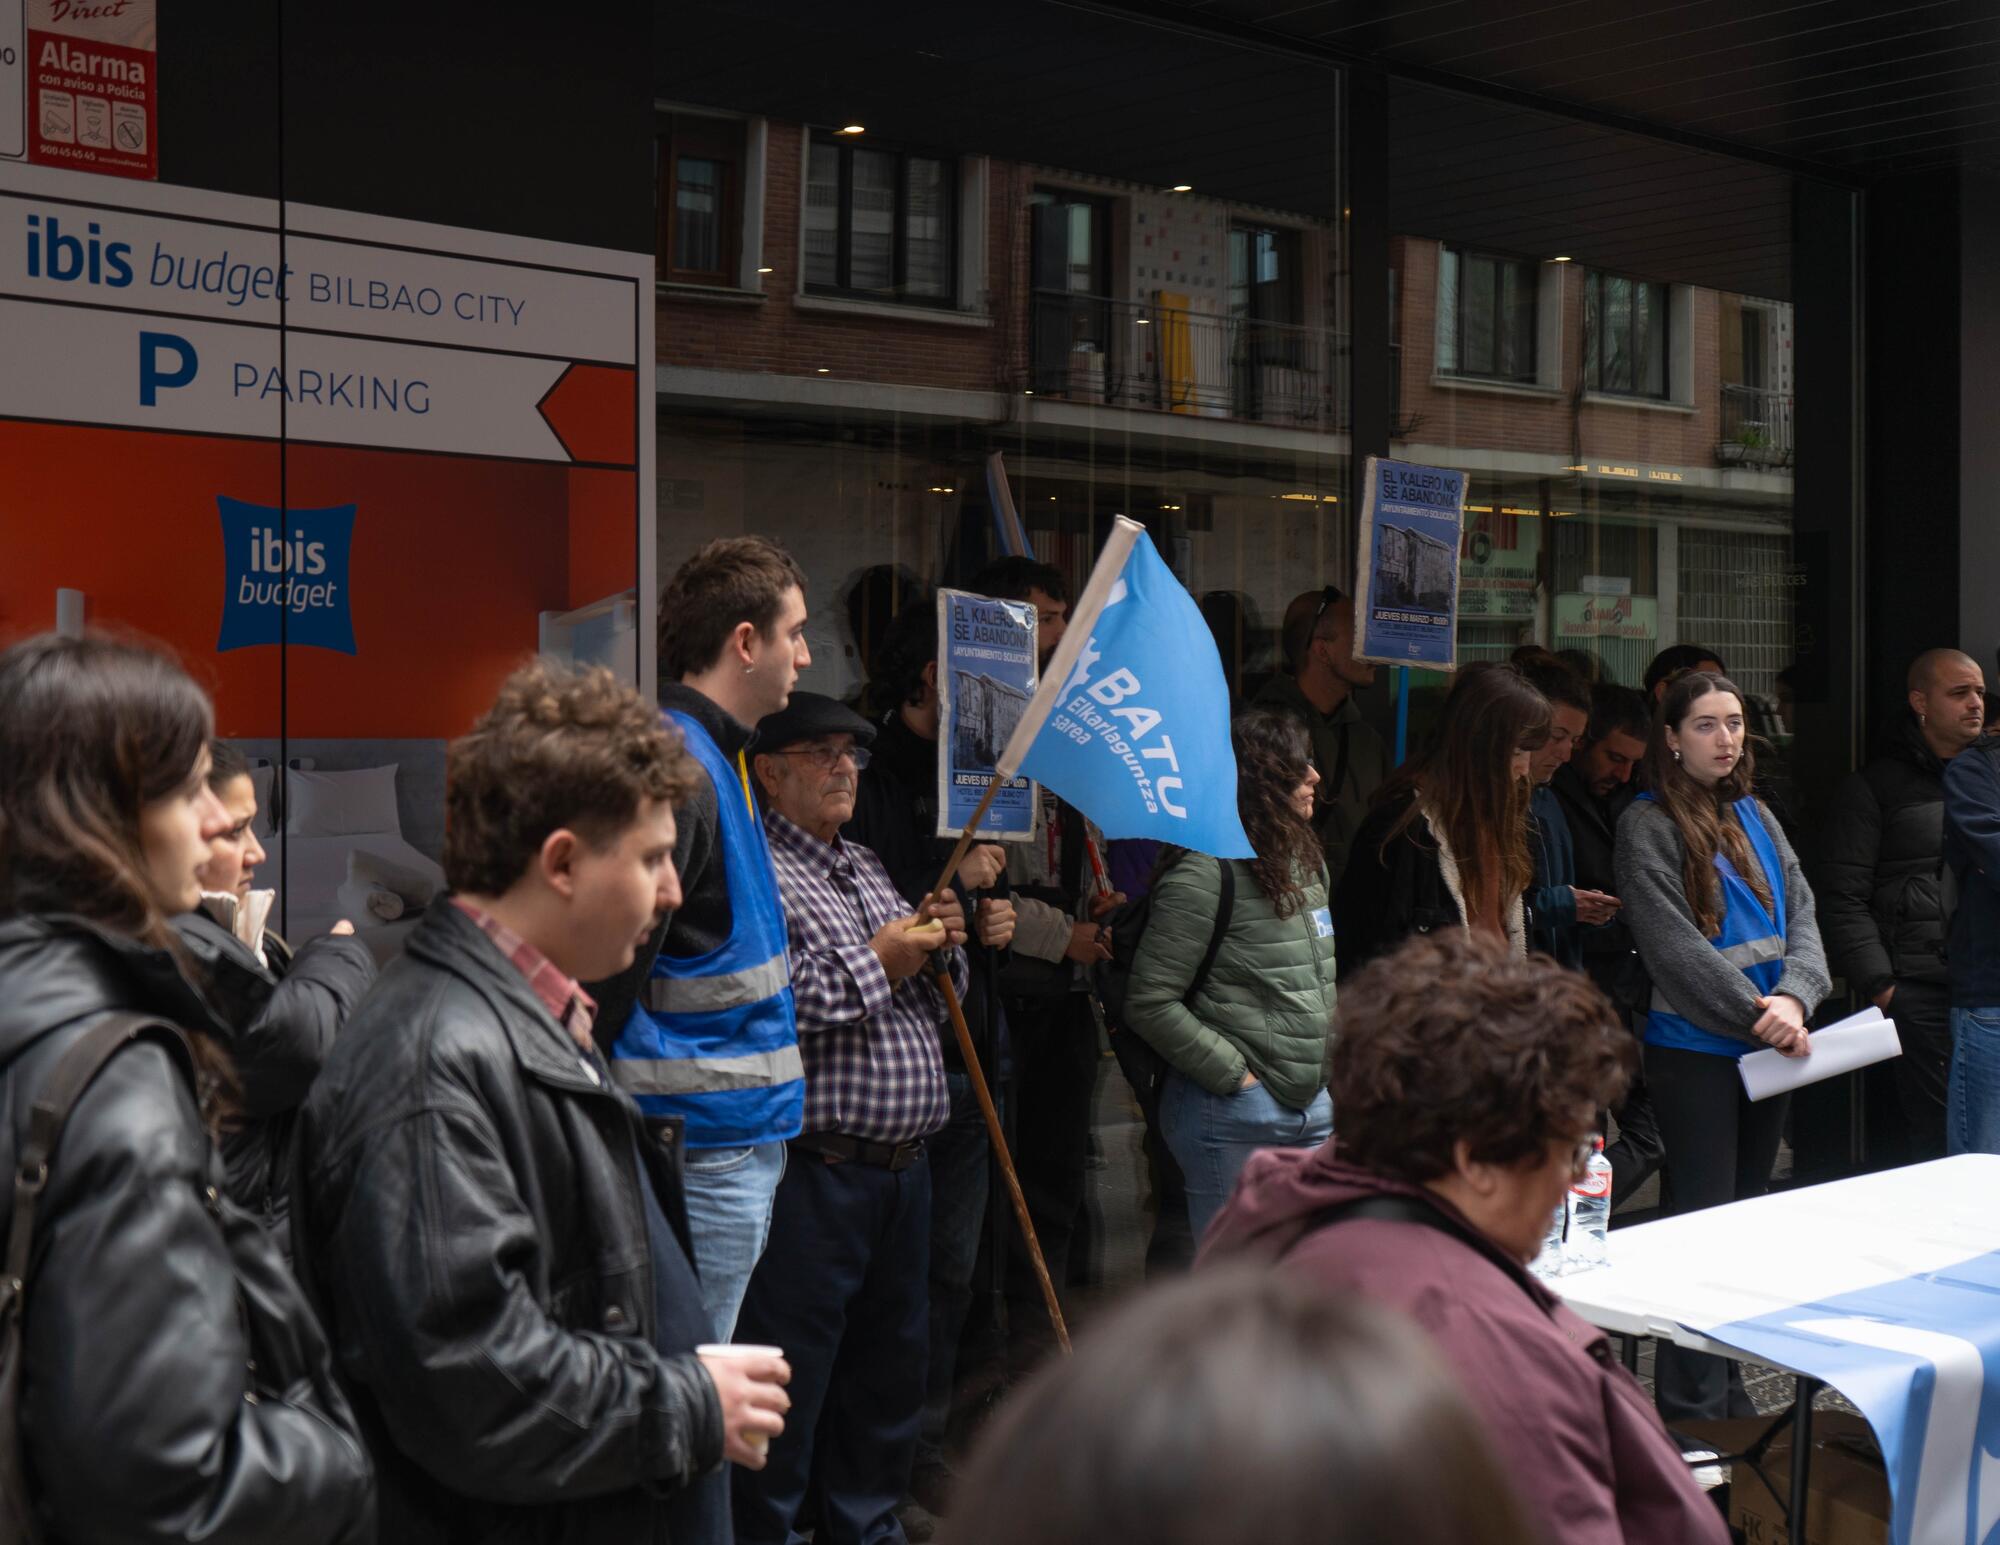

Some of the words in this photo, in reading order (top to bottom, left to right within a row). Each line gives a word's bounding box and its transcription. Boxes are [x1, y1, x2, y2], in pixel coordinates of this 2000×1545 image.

[51, 0, 132, 22] Direct
[39, 41, 146, 84] Alarma
[39, 73, 61, 87] con
[64, 76, 95, 92] aviso
[96, 83, 104, 93] a
[40, 144, 58, 157] 900
[59, 147, 71, 158] 45
[84, 150, 96, 162] 45
[26, 214, 133, 288] ibis
[149, 241, 294, 306] budget
[309, 272, 443, 317] BILBAO
[454, 293, 526, 326] CITY
[139, 331, 199, 408] P
[233, 362, 431, 415] PARKING
[1383, 469, 1398, 484] EL
[1400, 471, 1441, 490] KALERO
[1444, 478, 1458, 493] NO
[1383, 484, 1398, 499] SE
[1400, 488, 1456, 507] ABANDONA
[250, 527, 326, 576] ibis
[238, 575, 338, 614] budget
[955, 606, 969, 622] EL
[1375, 611, 1400, 621] JUEVES
[955, 624, 970, 641] SE
[1052, 714, 1093, 746] sarea
[1067, 695, 1158, 814] Elkarlaguntza
[1087, 667, 1187, 819] BATU
[956, 774, 980, 785] JUEVES
